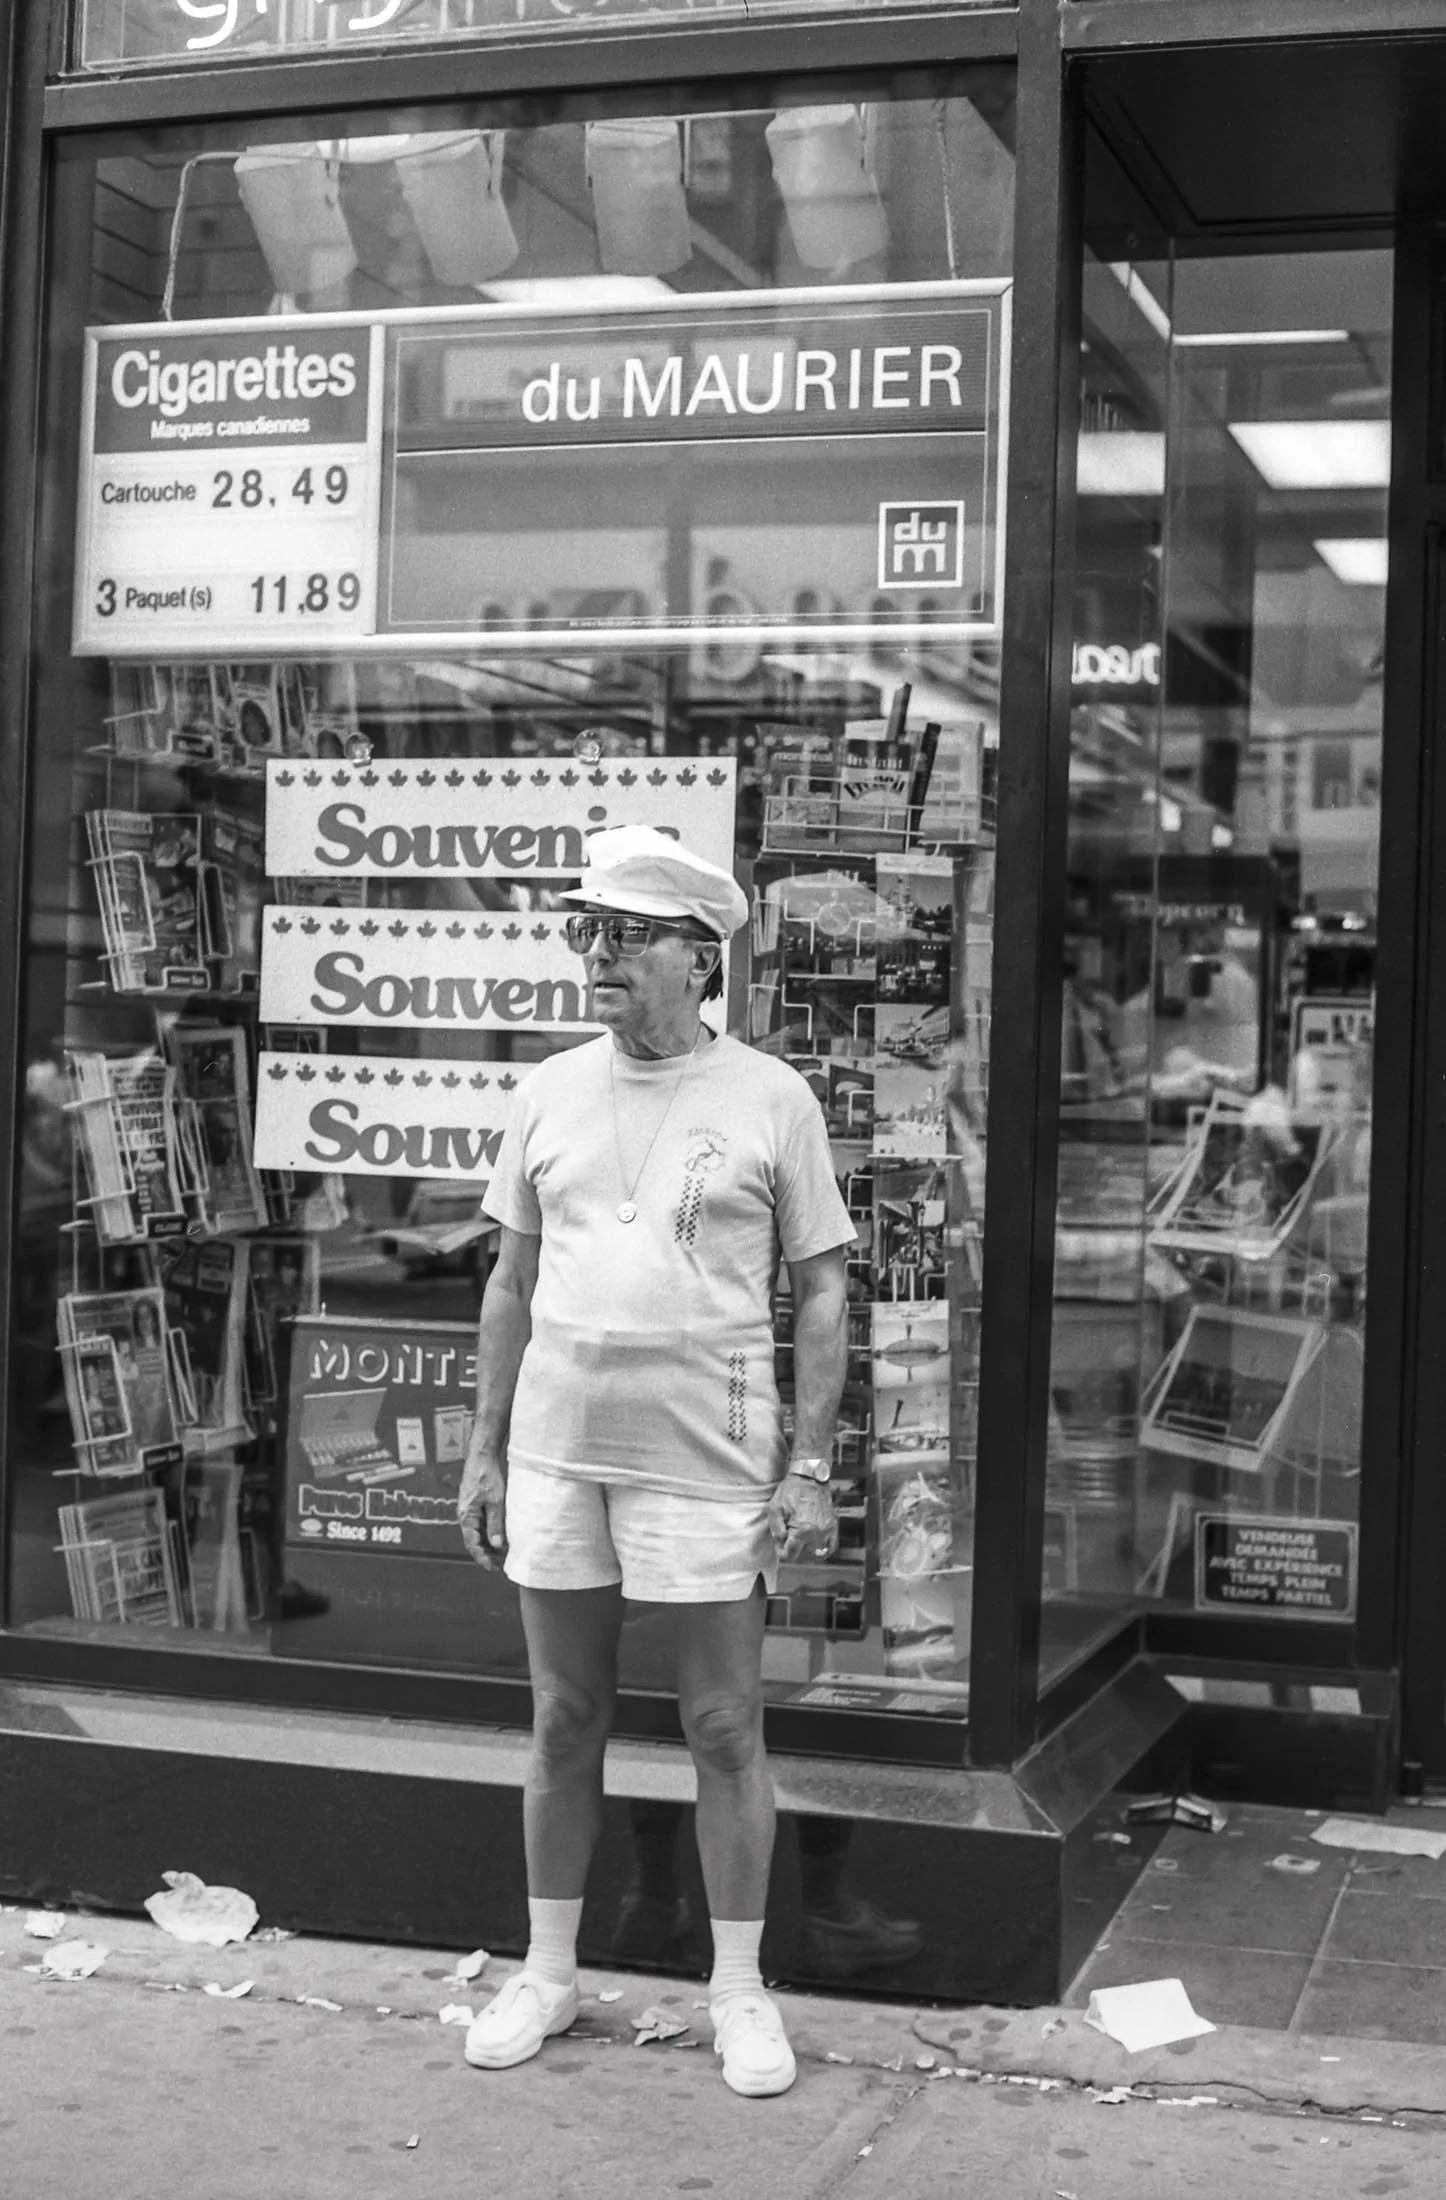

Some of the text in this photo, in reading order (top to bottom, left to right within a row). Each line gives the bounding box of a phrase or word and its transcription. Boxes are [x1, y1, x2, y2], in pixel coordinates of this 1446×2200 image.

[111, 345, 357, 417] Cigarettes
[521, 344, 963, 422] du MAURIER
[151, 416, 311, 441] Marques canadiennes
[101, 480, 196, 505] Cartouche
[96, 577, 118, 618] 3
[327, 1521, 367, 1542] Since
